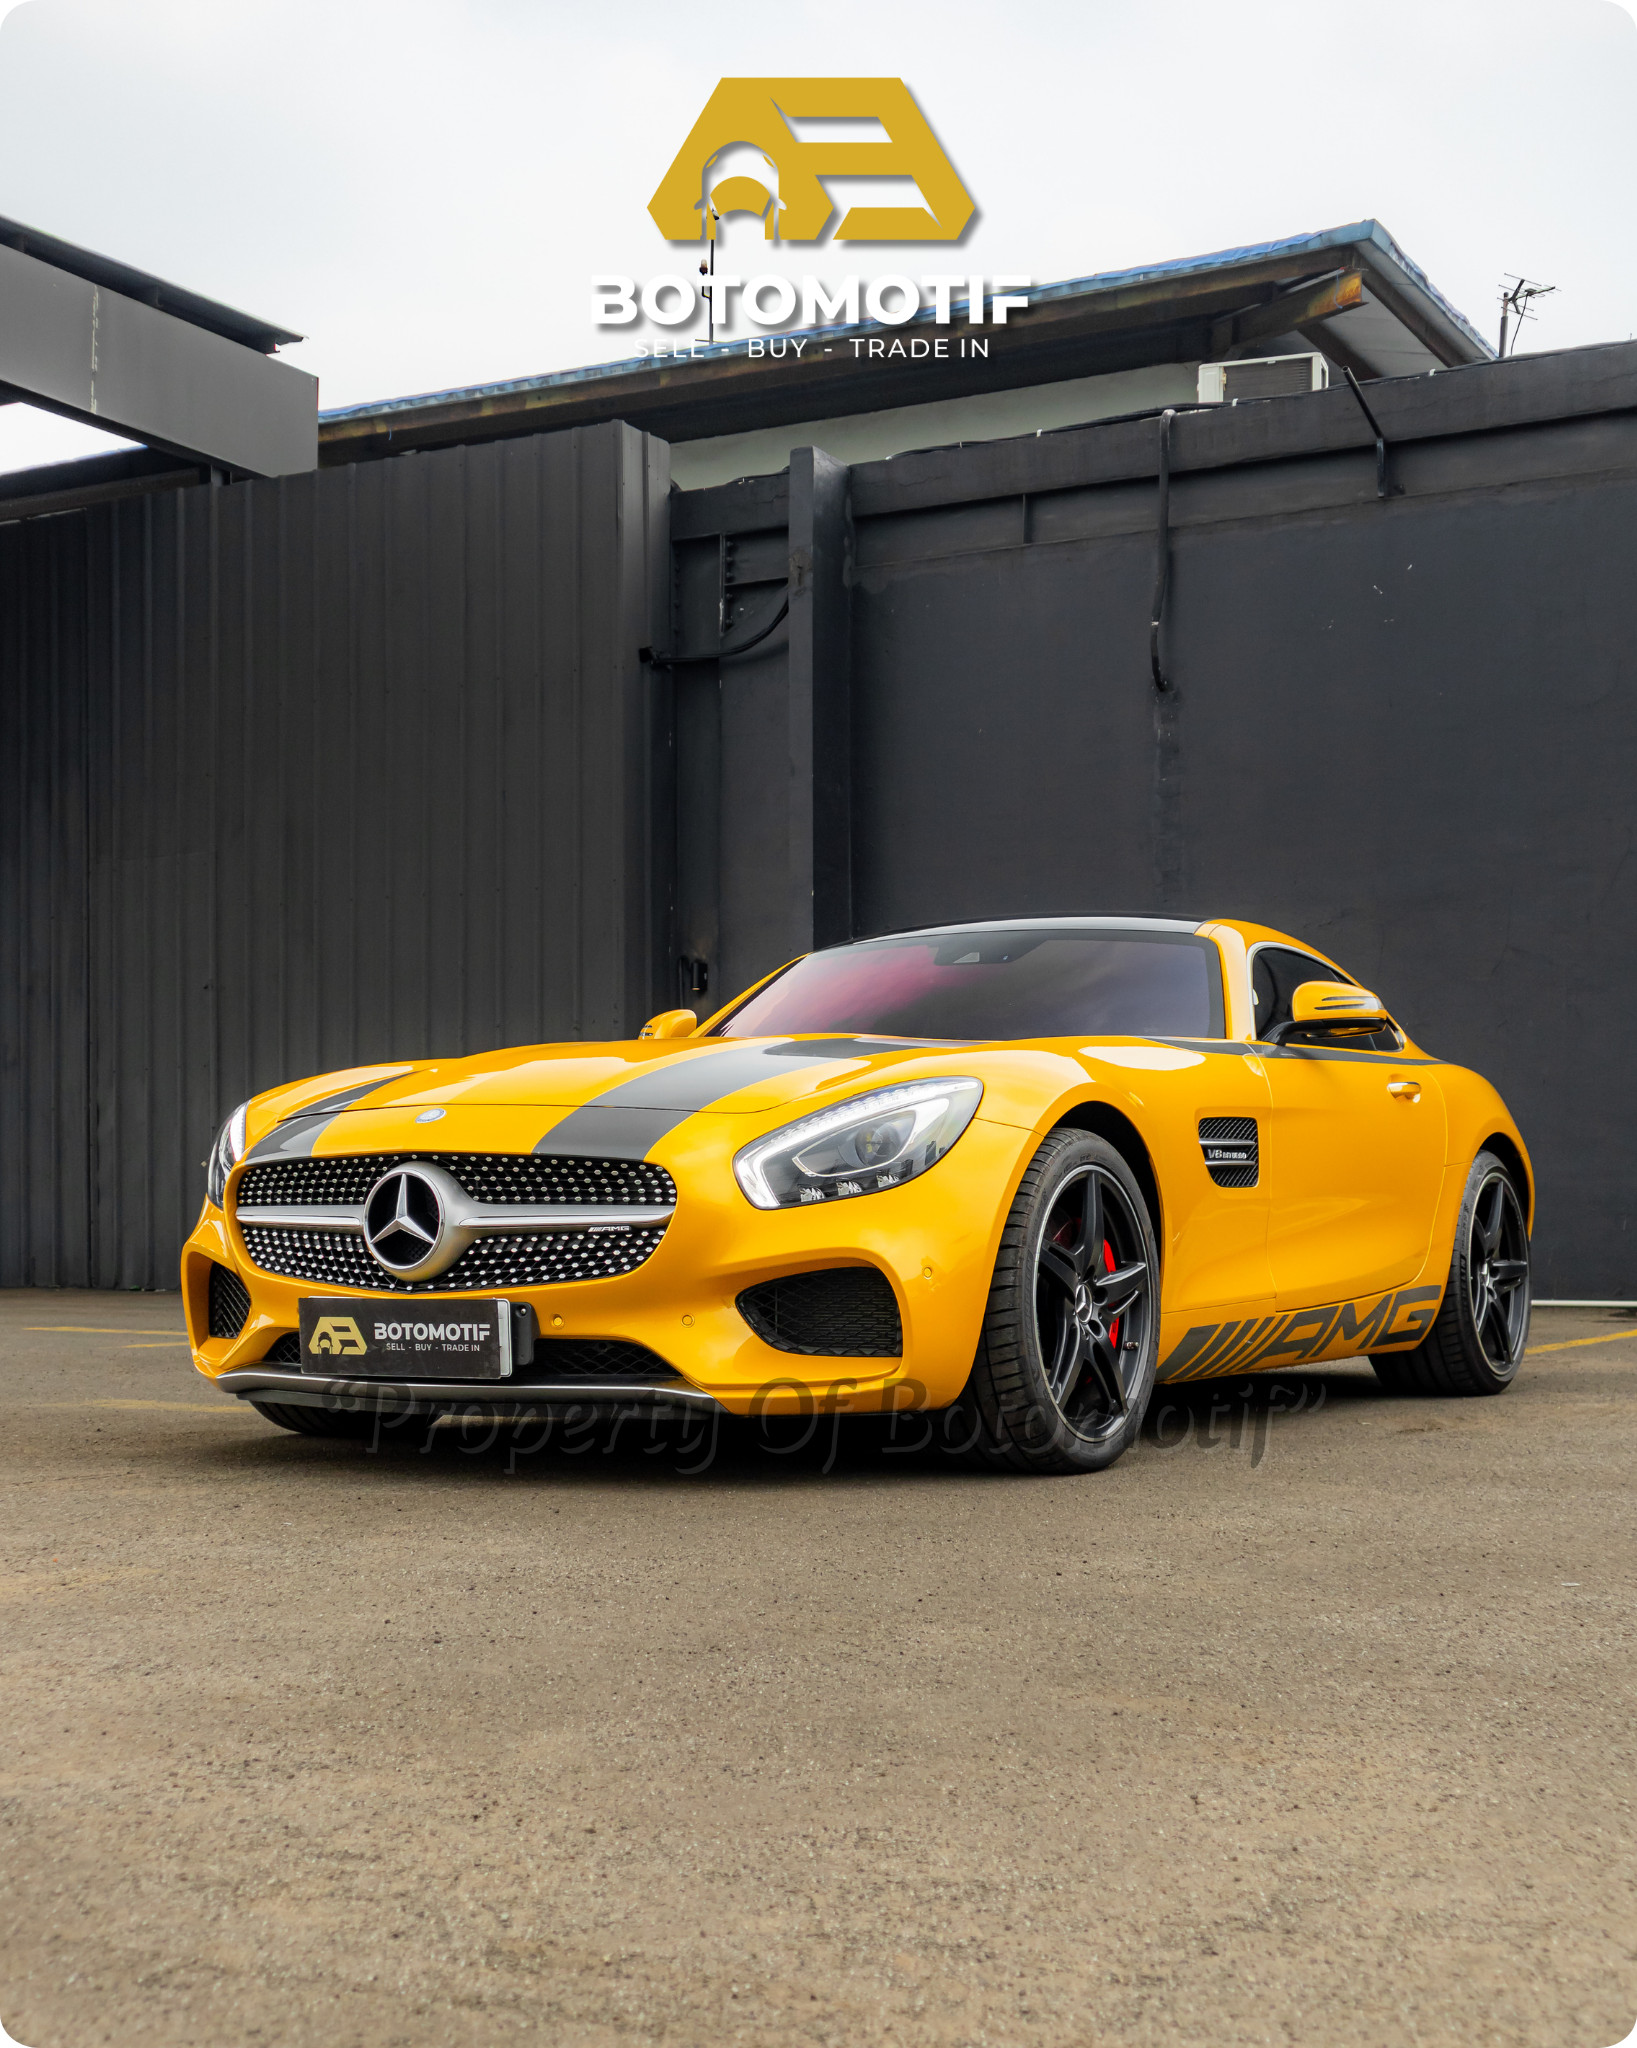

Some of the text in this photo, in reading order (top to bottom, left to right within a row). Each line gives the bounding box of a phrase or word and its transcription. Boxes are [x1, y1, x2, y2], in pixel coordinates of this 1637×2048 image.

[374, 1322, 491, 1341] BOTOMOTIF
[1235, 1285, 1442, 1371] AMG
[386, 1343, 406, 1351] SELL
[415, 1343, 432, 1351] BUY
[442, 1343, 470, 1352] TRADE
[471, 1344, 480, 1352] IN
